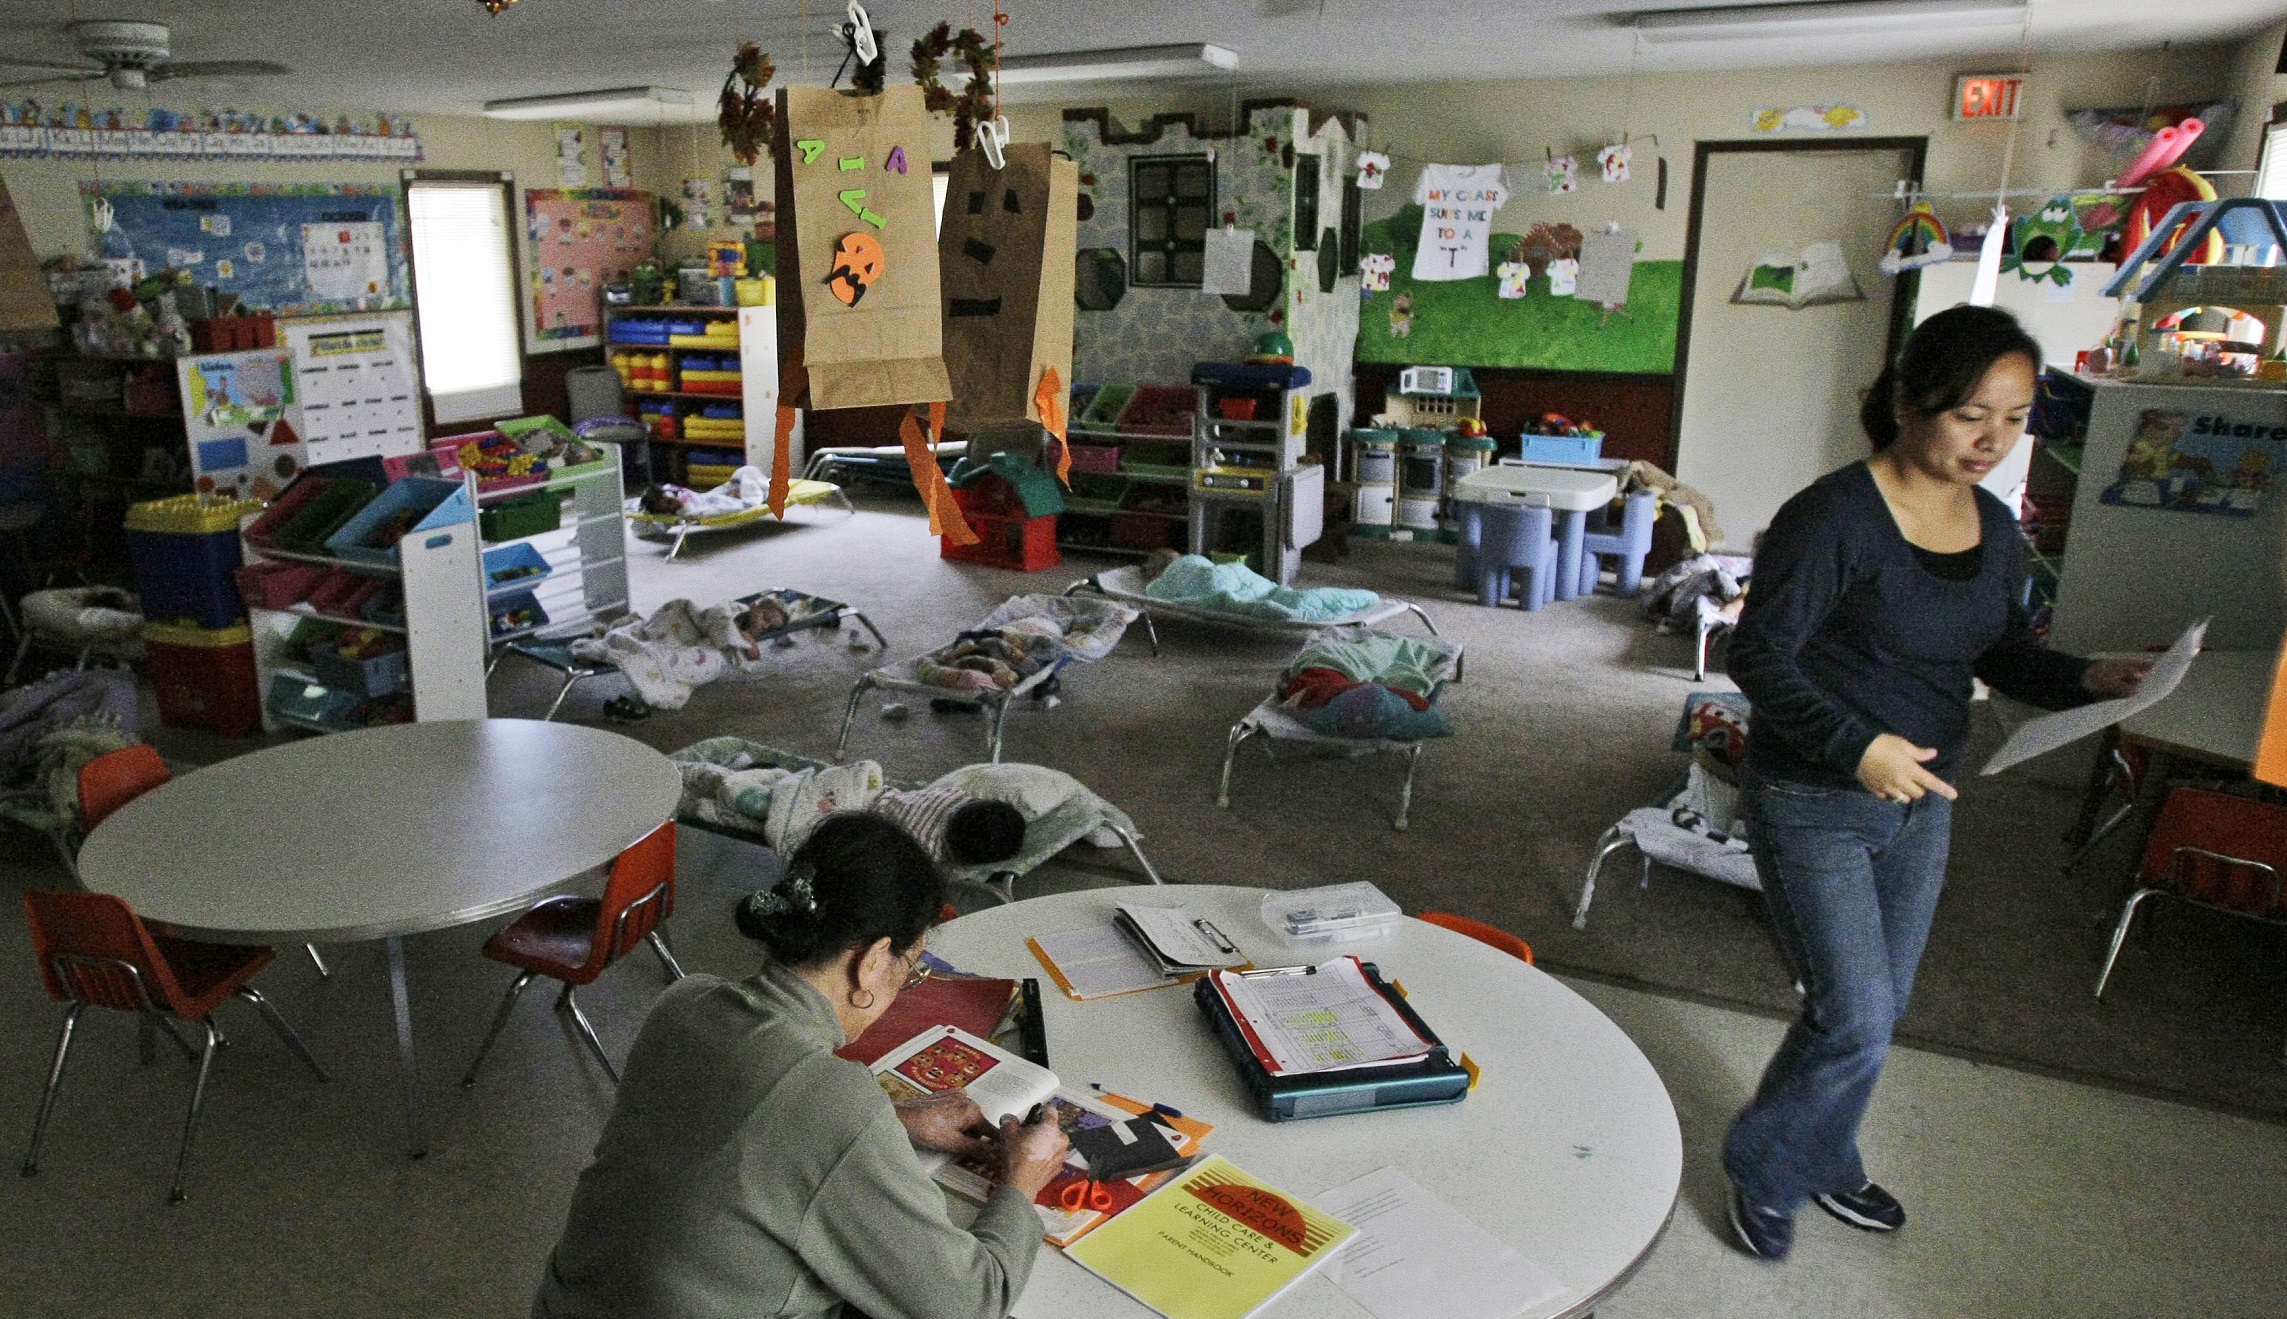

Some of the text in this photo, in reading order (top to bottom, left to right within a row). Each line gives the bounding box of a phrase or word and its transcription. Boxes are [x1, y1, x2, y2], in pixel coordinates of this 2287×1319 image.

[1962, 79, 2022, 117] EXIT
[1428, 188, 1498, 202] MY CLASS
[1468, 210, 1486, 222] ME
[1438, 227, 1473, 240] TO A
[2195, 415, 2287, 441] Share
[1206, 1186, 1305, 1244] HORIZONS
[1247, 1190, 1294, 1216] NEW
[1174, 1202, 1231, 1238] LEARNING
[1233, 1237, 1278, 1264] CENTER
[1196, 1203, 1230, 1224] CHILD
[1231, 1223, 1264, 1242] CARE
[1264, 1241, 1274, 1249] &
[1157, 1231, 1187, 1249] PARENT
[1186, 1248, 1235, 1278] HANDBOOK
